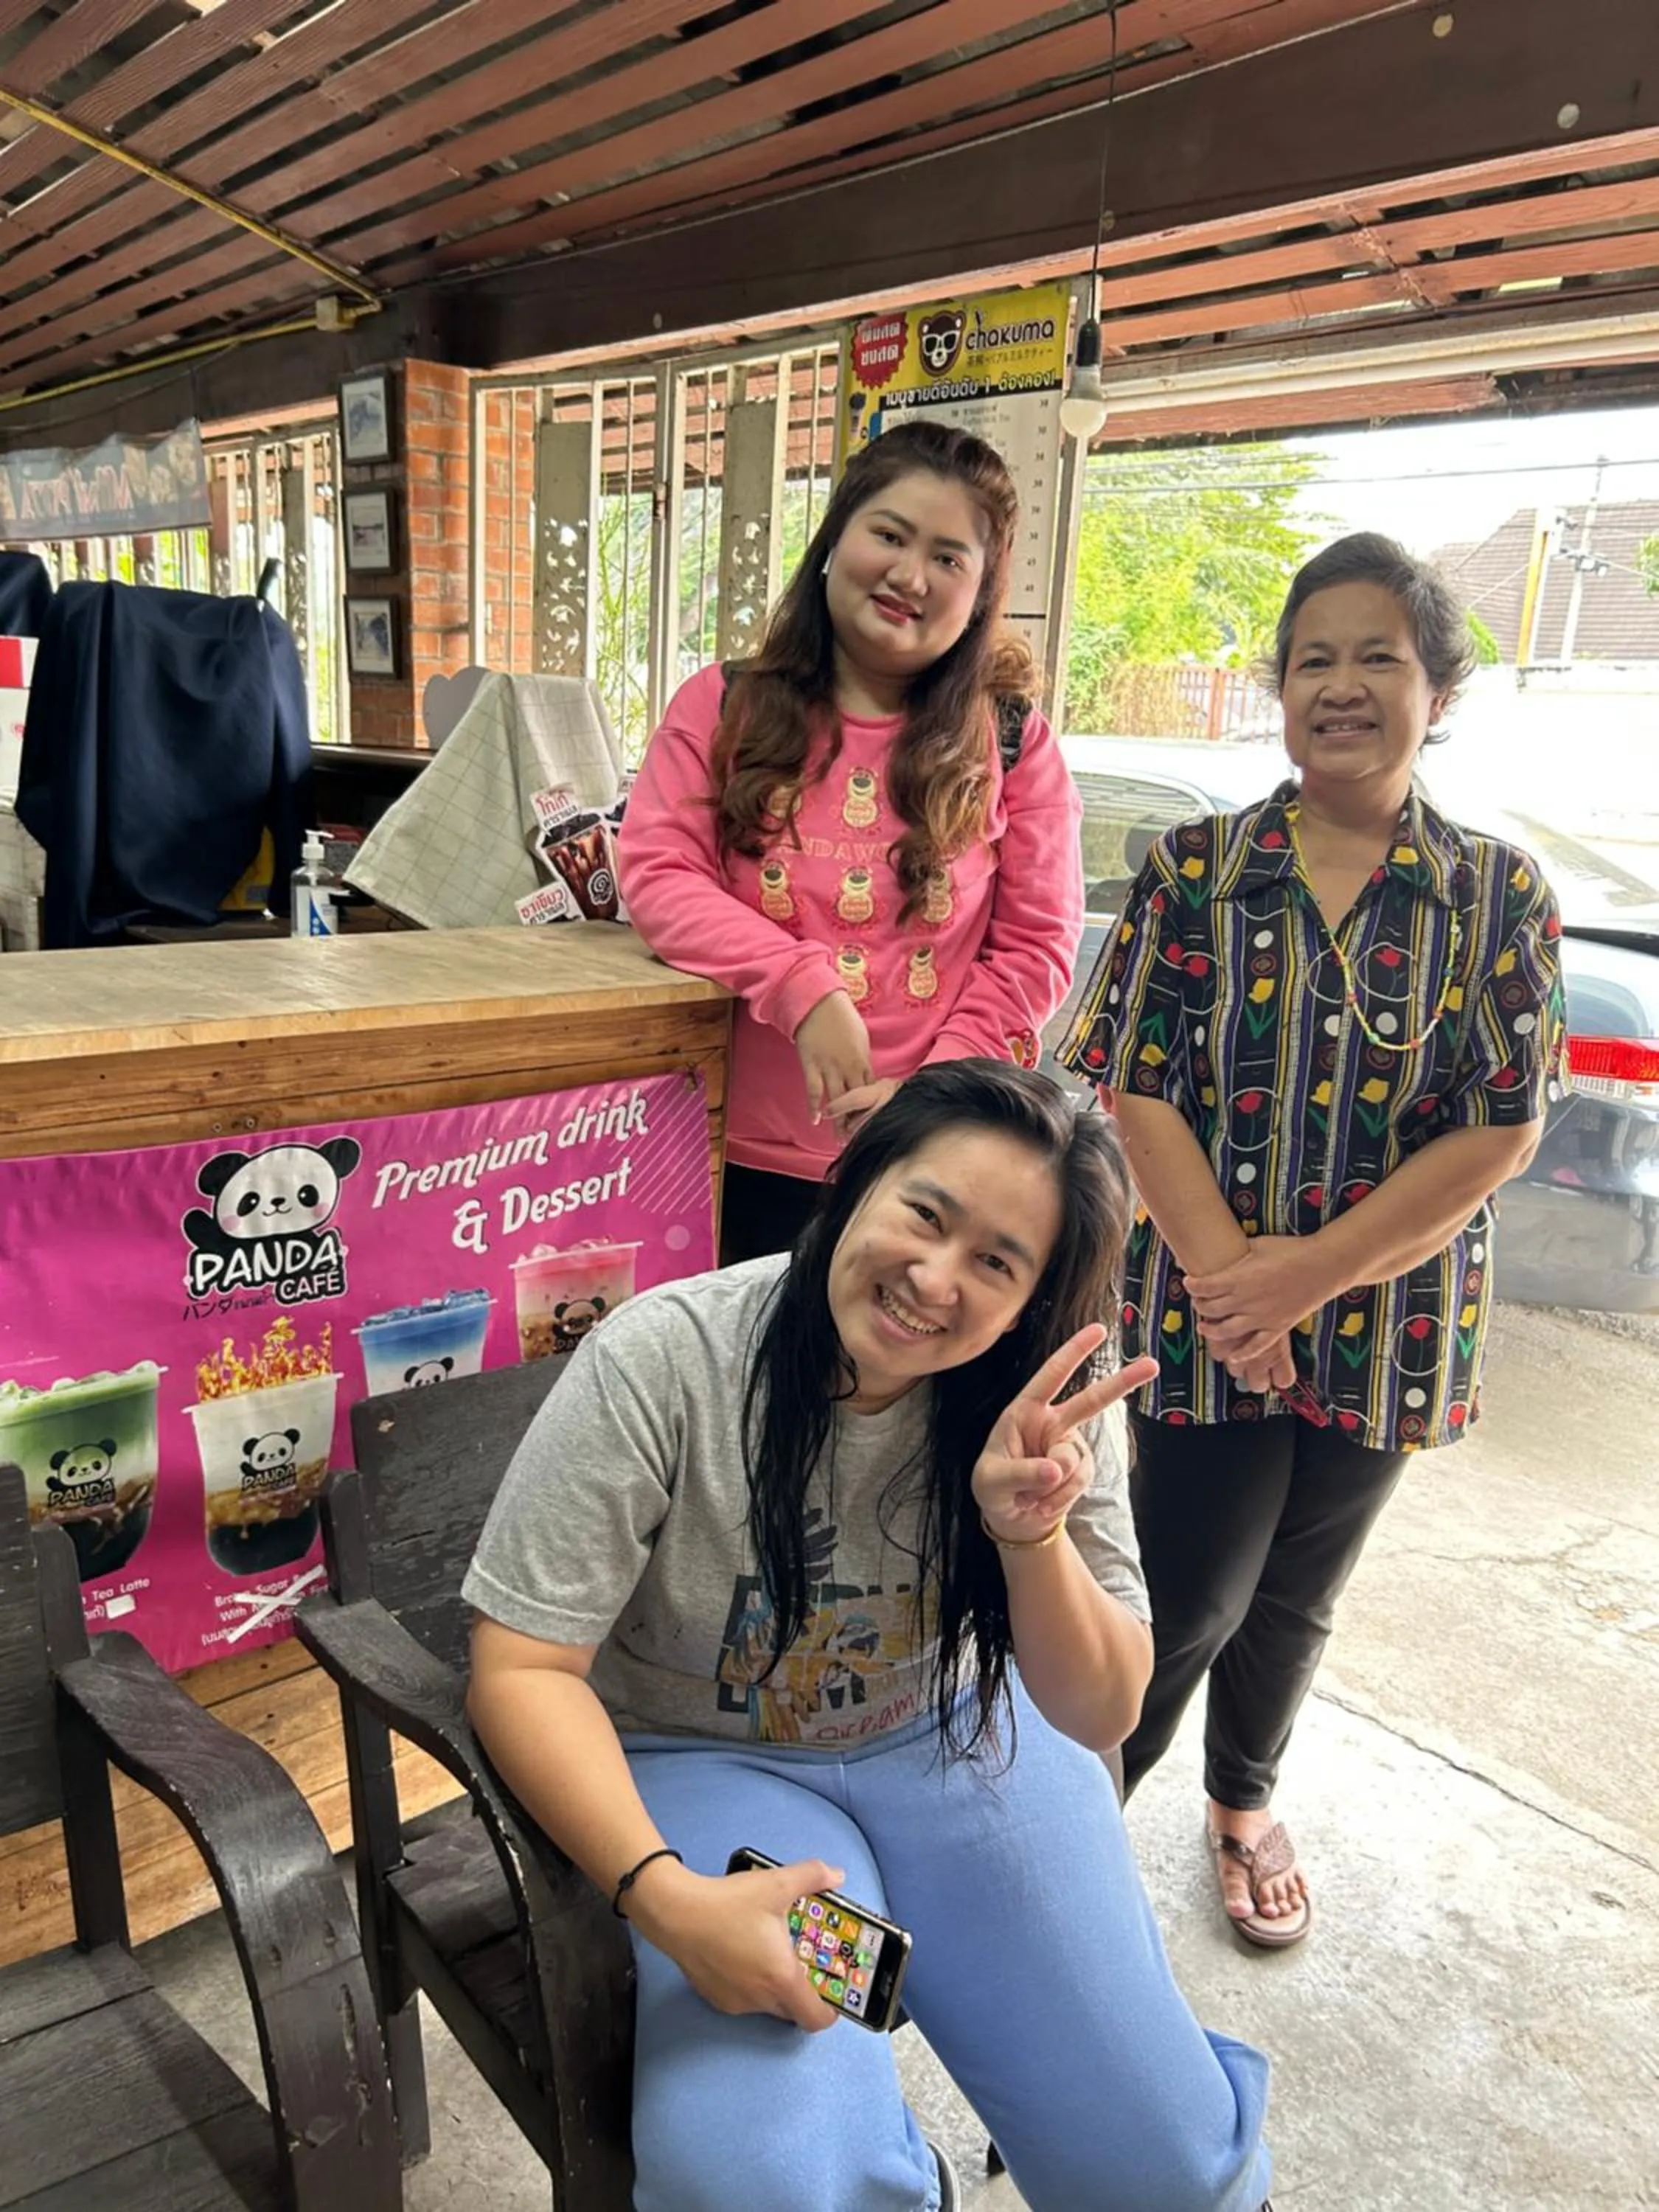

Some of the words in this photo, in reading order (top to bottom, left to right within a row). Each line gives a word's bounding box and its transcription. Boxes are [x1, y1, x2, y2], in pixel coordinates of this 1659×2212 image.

[965, 310, 1055, 350] chakuma
[372, 1130, 549, 1208] Premium
[557, 1088, 649, 1149] drink
[452, 1199, 488, 1254] &
[500, 1156, 633, 1234] Dessert
[195, 1235, 338, 1291] PANDA
[280, 1266, 341, 1300] CAFÉ
[50, 1480, 114, 1505] PANDA
[243, 1464, 295, 1489] PANDA
[92, 1588, 114, 1601] Tea
[120, 1579, 150, 1593] Latte
[255, 1579, 288, 1594] Sugar
